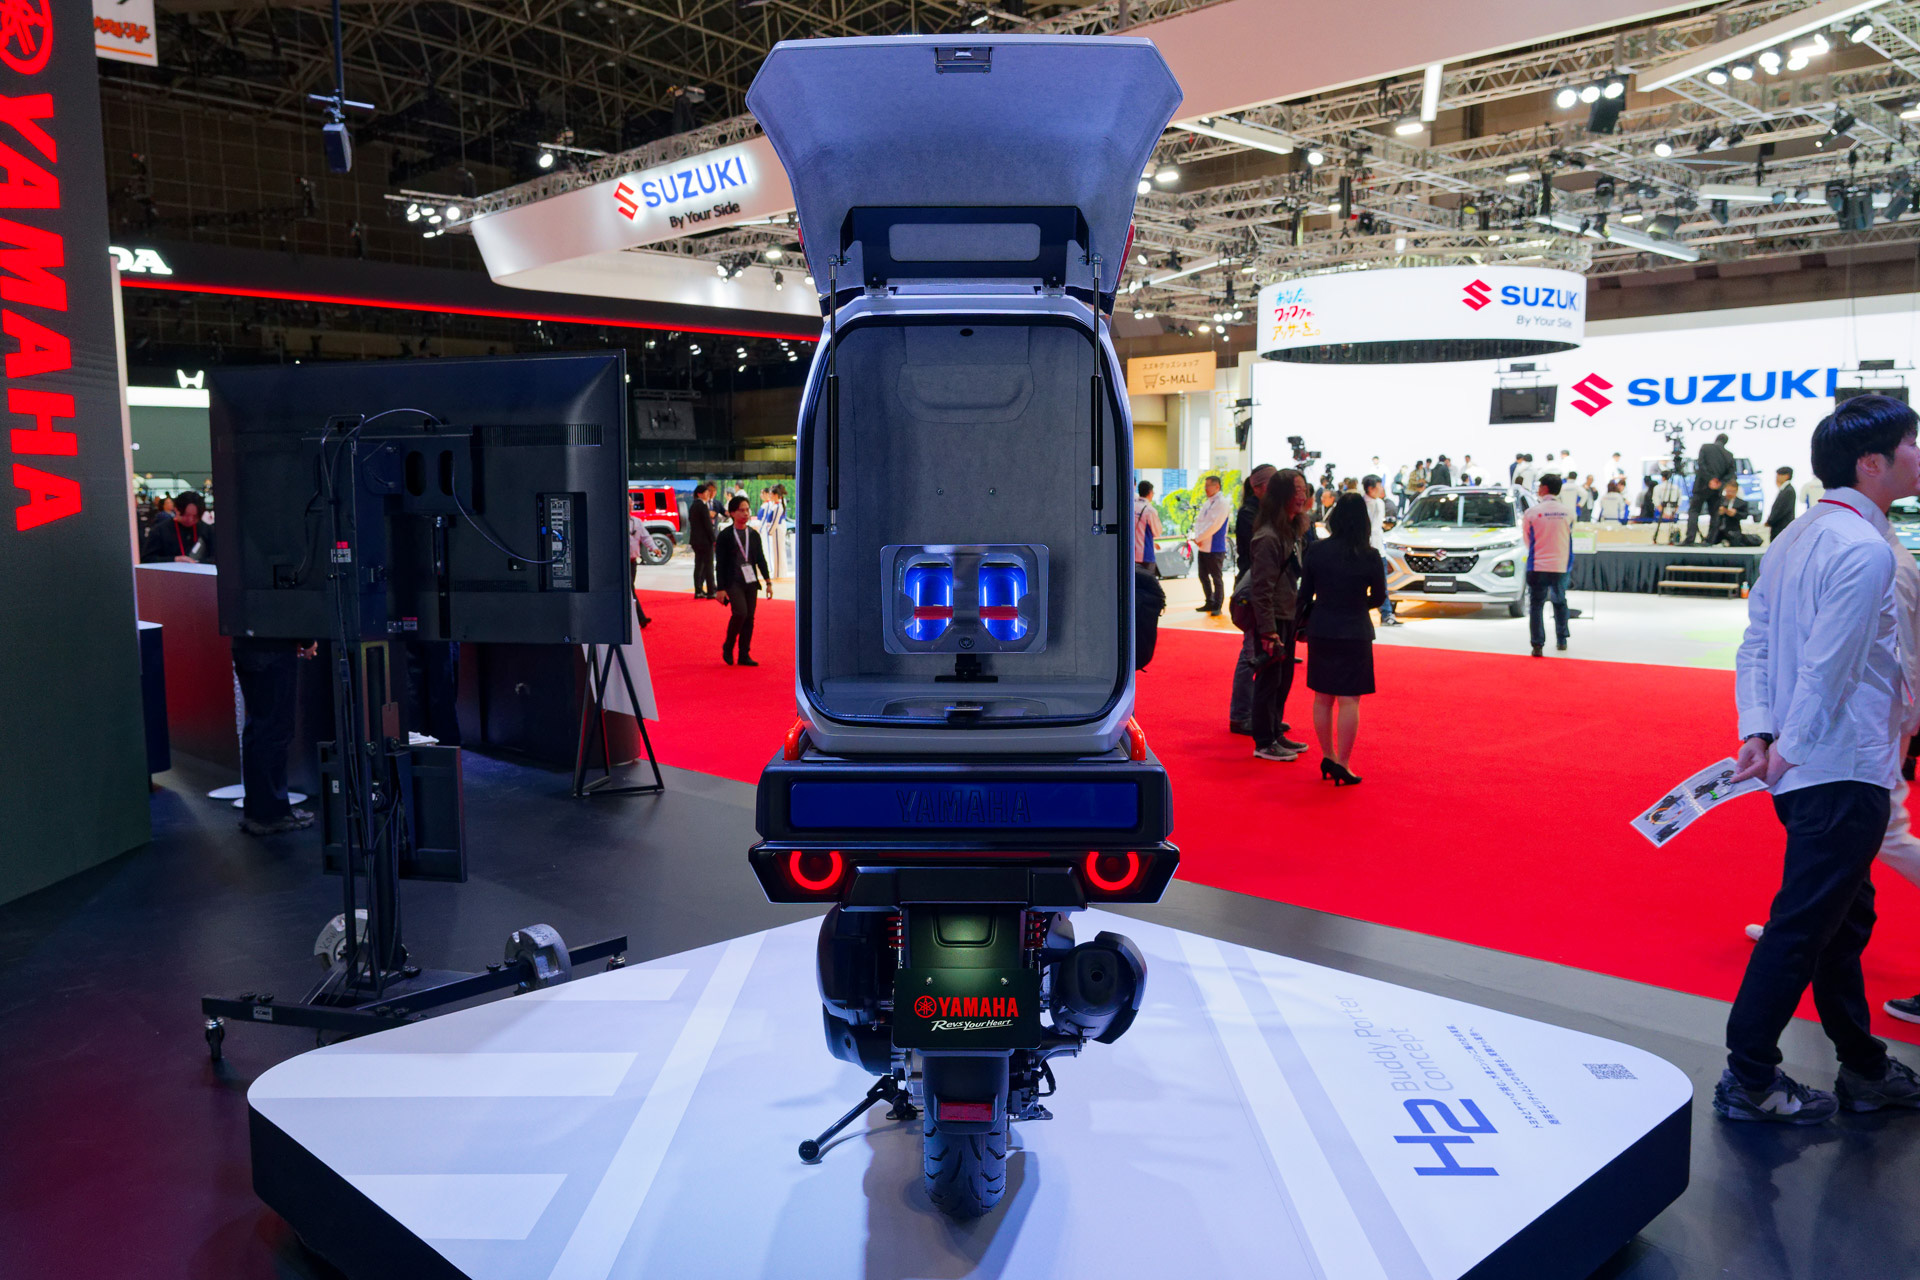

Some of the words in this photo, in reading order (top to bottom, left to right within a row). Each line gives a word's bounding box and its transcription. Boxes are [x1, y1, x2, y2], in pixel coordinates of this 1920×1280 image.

[642, 156, 748, 208] SUZUKI
[669, 215, 684, 229] By
[684, 211, 712, 224] Your
[713, 201, 740, 218] Side
[0, 93, 82, 531] YAMAHA
[1501, 285, 1578, 311] SUZUK
[1516, 315, 1531, 327] By
[1534, 316, 1556, 327] Your
[1159, 373, 1198, 386] S-MALL
[1627, 368, 1838, 407] SUZUKI
[1653, 418, 1683, 434] By
[1687, 417, 1738, 432] Your
[1744, 414, 1796, 429] Side
[896, 790, 1031, 823] YAMAHA
[938, 997, 1019, 1017] YAMAHA
[1335, 995, 1382, 1038] Porter
[1367, 1041, 1421, 1091] Buddy
[1387, 1027, 1454, 1092] Concept
[1393, 1099, 1500, 1176] H2
